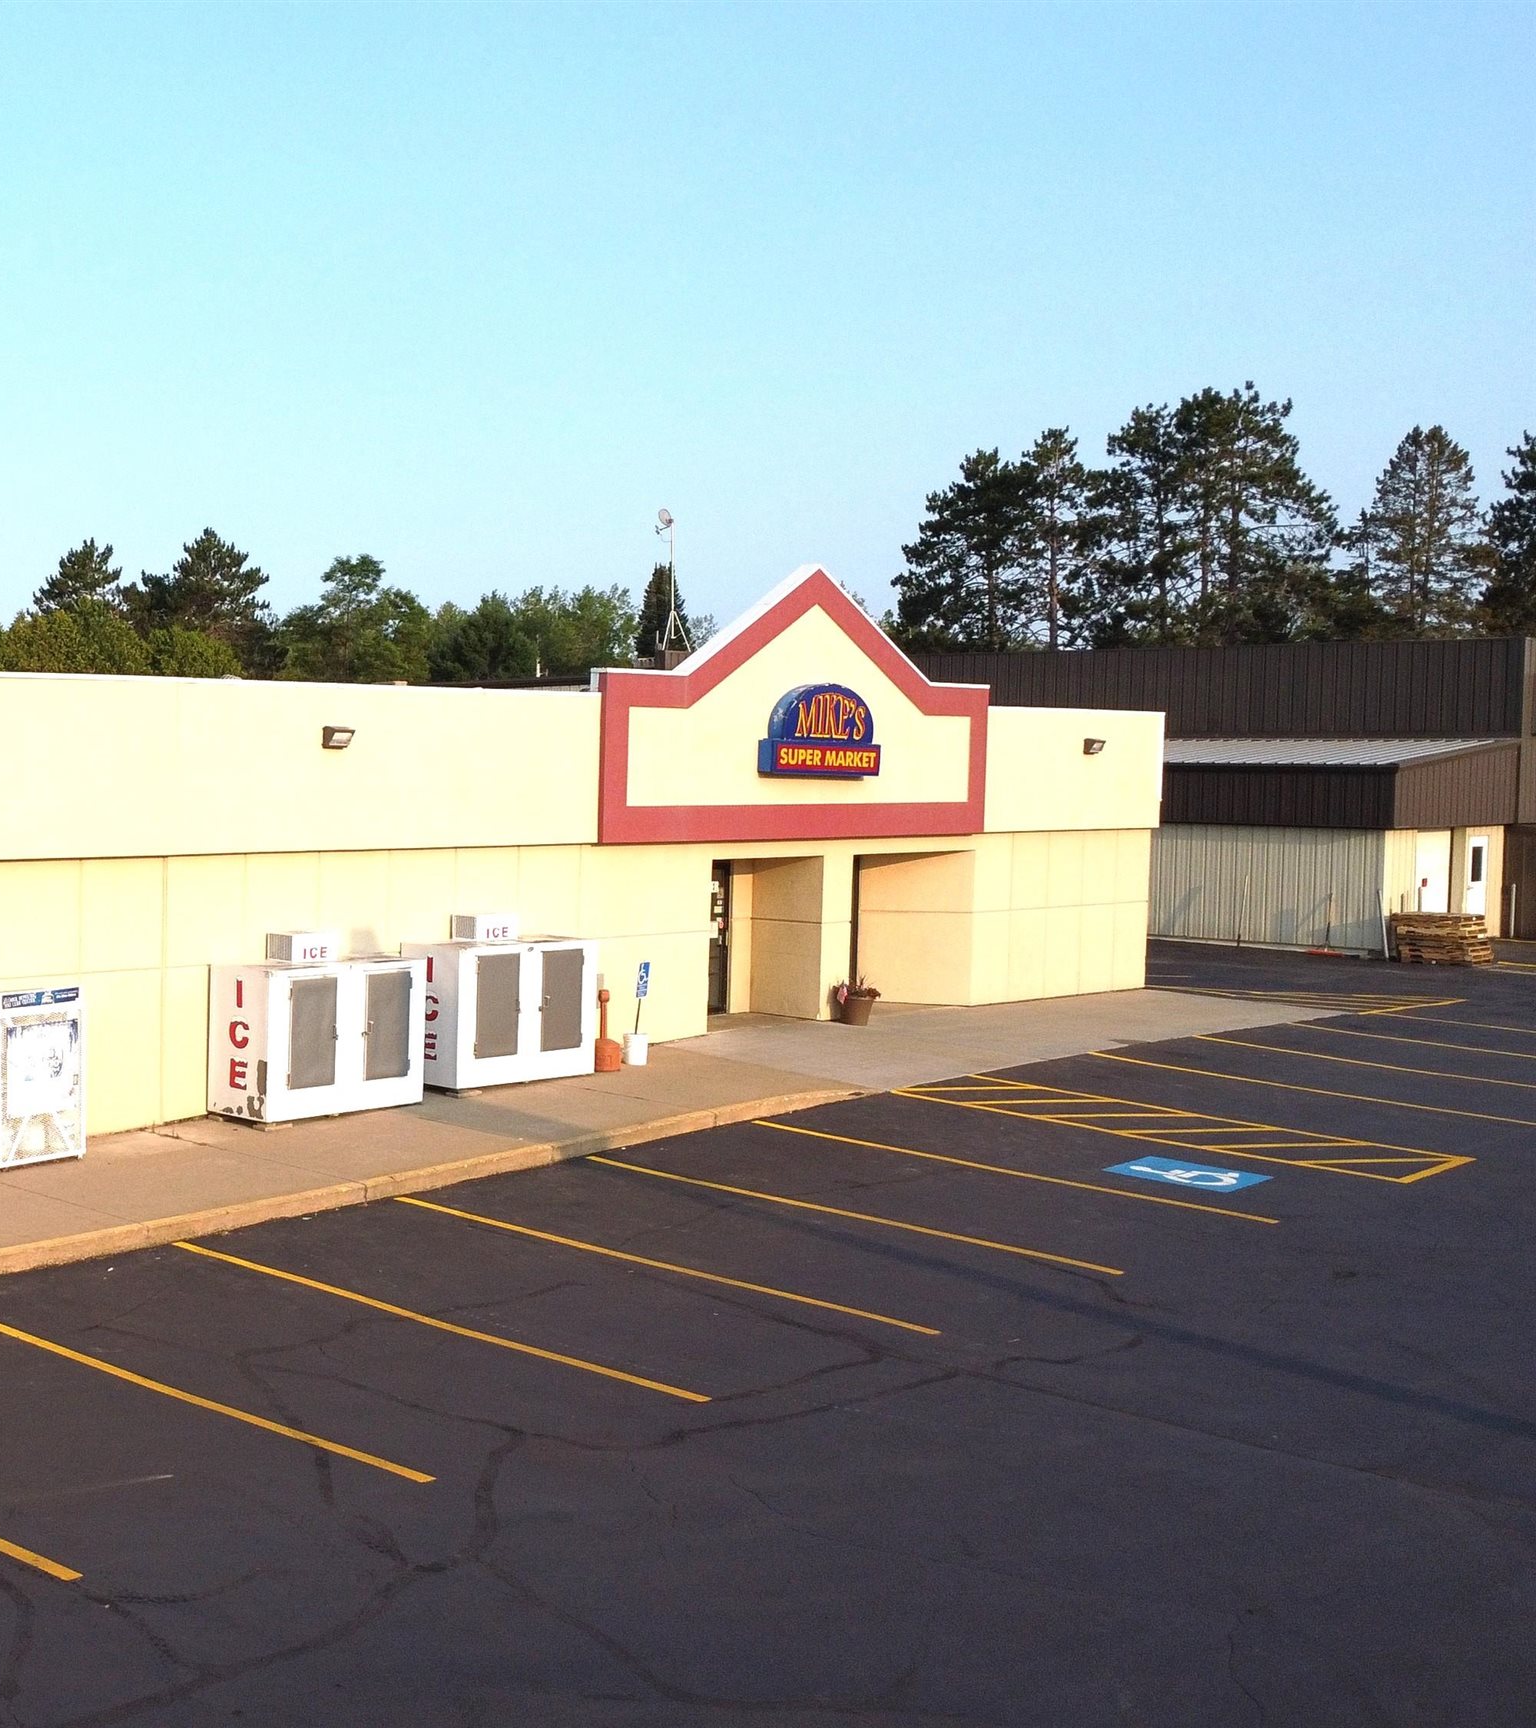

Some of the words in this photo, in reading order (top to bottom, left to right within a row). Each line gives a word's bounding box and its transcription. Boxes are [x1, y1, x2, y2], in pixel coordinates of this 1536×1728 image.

[794, 692, 866, 740] MIKE'S
[779, 748, 821, 766] SUPER
[824, 750, 876, 768] MARKET
[486, 926, 509, 939] ICE
[303, 946, 328, 960] ICE
[229, 976, 250, 1091] ICE
